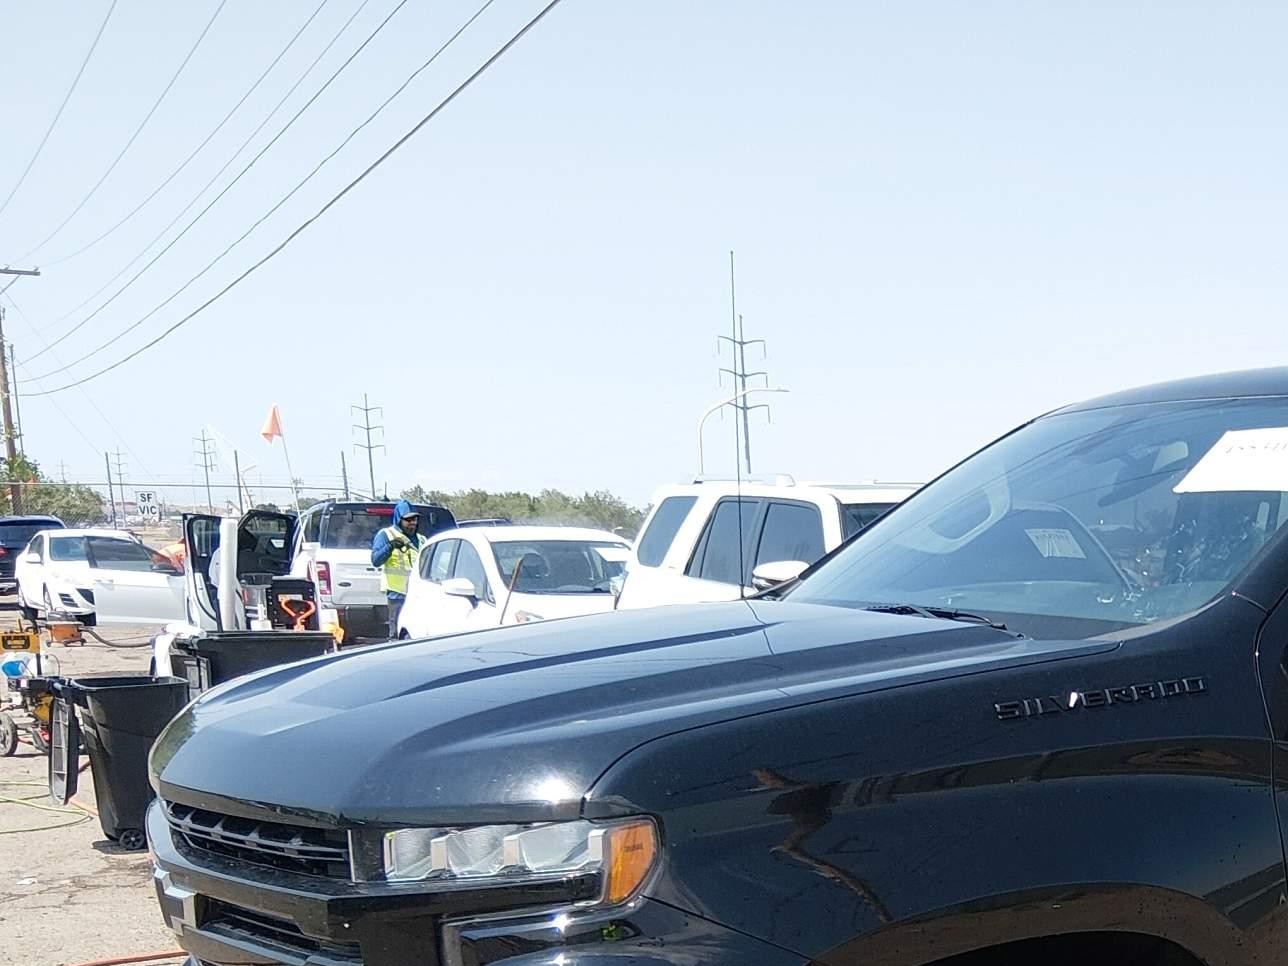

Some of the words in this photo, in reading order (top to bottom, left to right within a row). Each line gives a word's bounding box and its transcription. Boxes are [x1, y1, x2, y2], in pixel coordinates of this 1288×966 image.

[140, 493, 152, 502] SF
[139, 505, 157, 515] VIC
[994, 675, 1209, 720] SILVERADO
